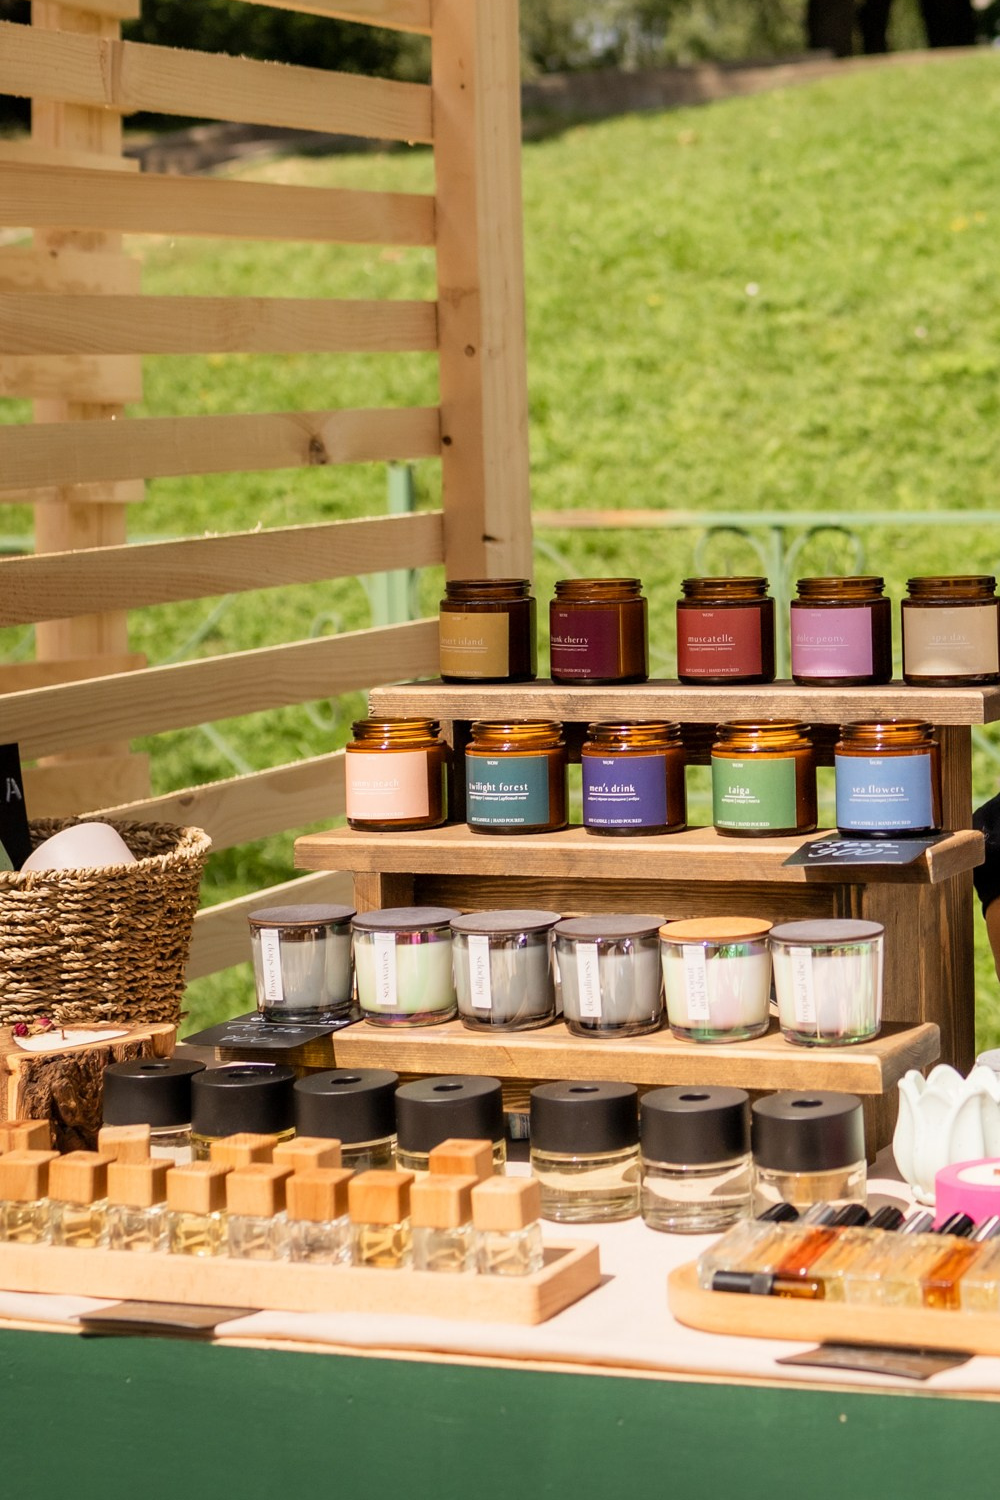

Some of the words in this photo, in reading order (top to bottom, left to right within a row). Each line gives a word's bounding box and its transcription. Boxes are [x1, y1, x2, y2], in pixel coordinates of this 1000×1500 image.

[458, 637, 483, 646] island
[564, 635, 589, 645] cherry
[688, 634, 734, 643] muscatelle
[816, 636, 845, 645] peony
[373, 778, 399, 788] peach
[469, 782, 496, 793] twilight
[499, 782, 529, 791] forest
[589, 783, 609, 793] men's
[611, 784, 635, 793] drink
[728, 785, 750, 797] taiga
[868, 785, 905, 794] flowers
[266, 943, 275, 966] shop
[475, 956, 486, 995] lollipops
[268, 970, 277, 997] flower
[583, 960, 594, 1011] cleanliness
